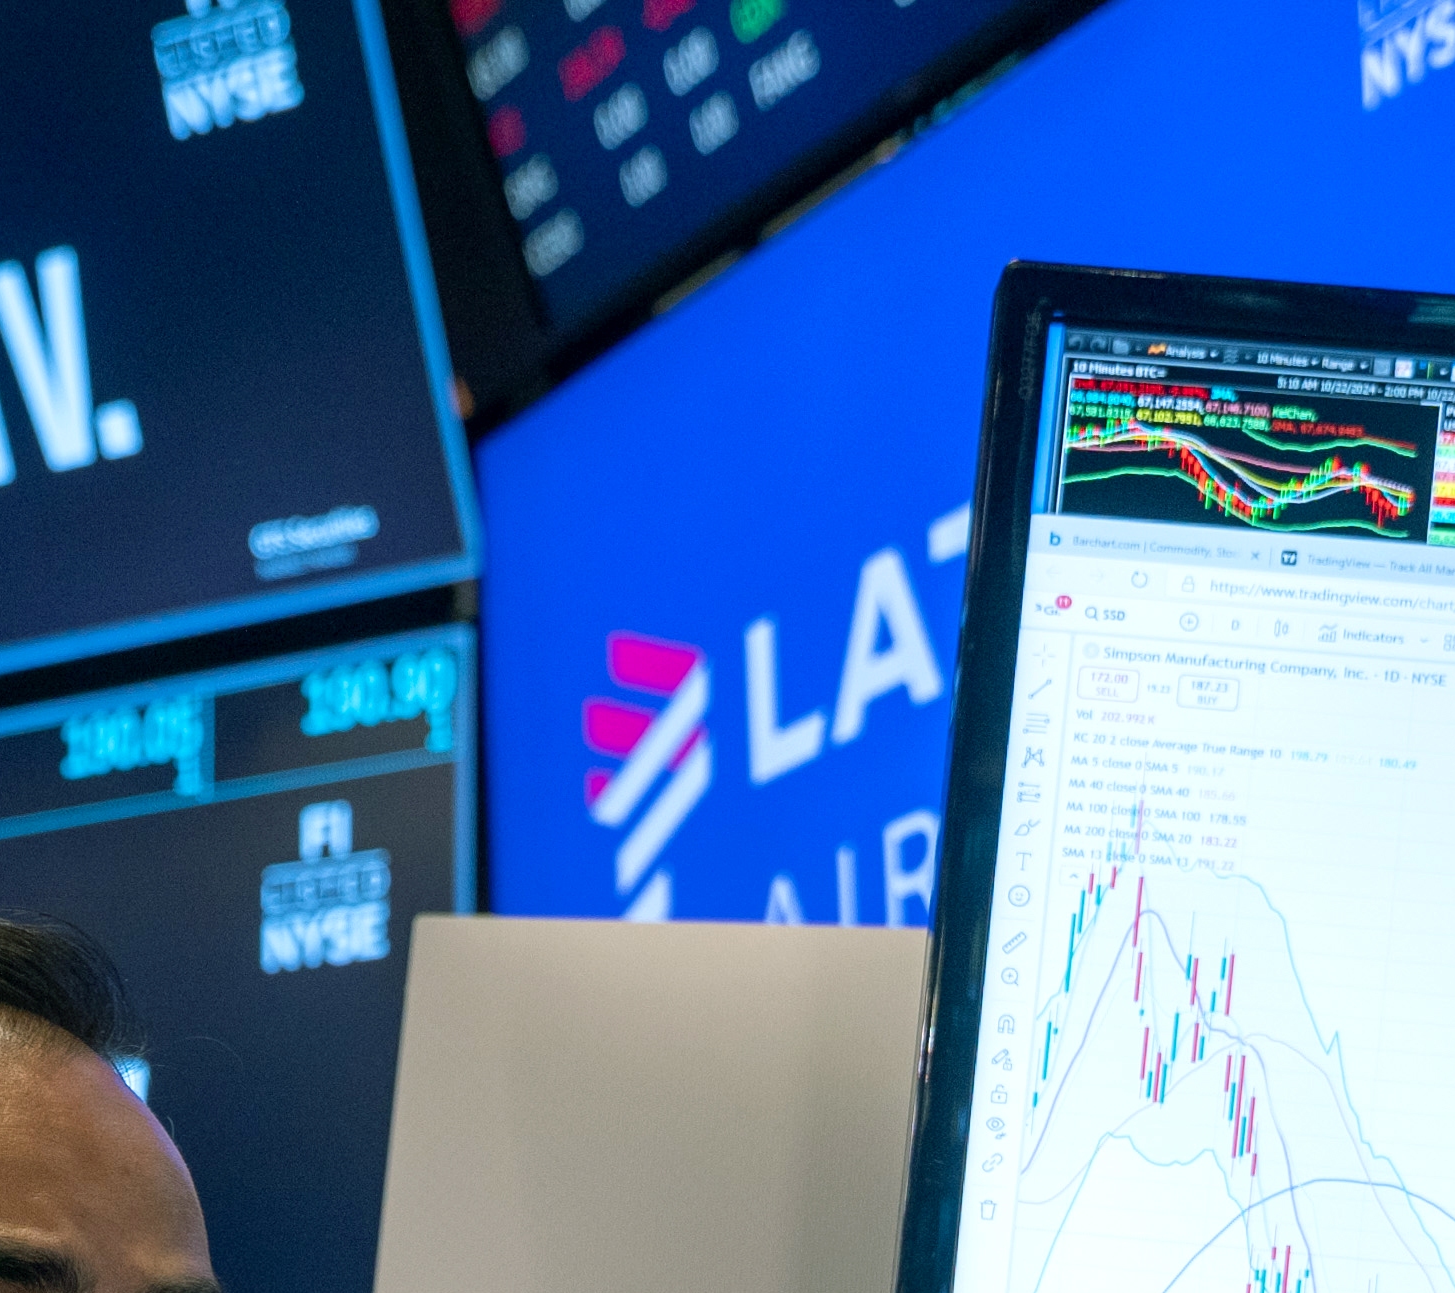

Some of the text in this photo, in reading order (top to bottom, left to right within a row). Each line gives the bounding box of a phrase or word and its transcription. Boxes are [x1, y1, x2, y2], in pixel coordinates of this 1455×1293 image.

[162, 46, 305, 141] NYSE
[1307, 554, 1371, 570] TradingView
[1390, 561, 1416, 573] Track
[1417, 563, 1433, 574] All
[1103, 609, 1126, 622] SSD
[1342, 629, 1405, 645] Indicators
[1103, 647, 1447, 687] Simpson Manufacturing Company, Inc. NYSE
[1095, 686, 1120, 698] SELL
[1196, 696, 1218, 706] BUY
[1075, 709, 1093, 720] Vol
[1073, 732, 1282, 760] KC 20 close Average True Range 10
[1071, 756, 1168, 773] MA SMA
[1068, 778, 1173, 796] MA SMA
[1066, 802, 1178, 820] MA SMA
[1064, 825, 1175, 843] MA SMA
[1062, 848, 1173, 866] SMA SMA
[259, 904, 391, 975] NYSE
